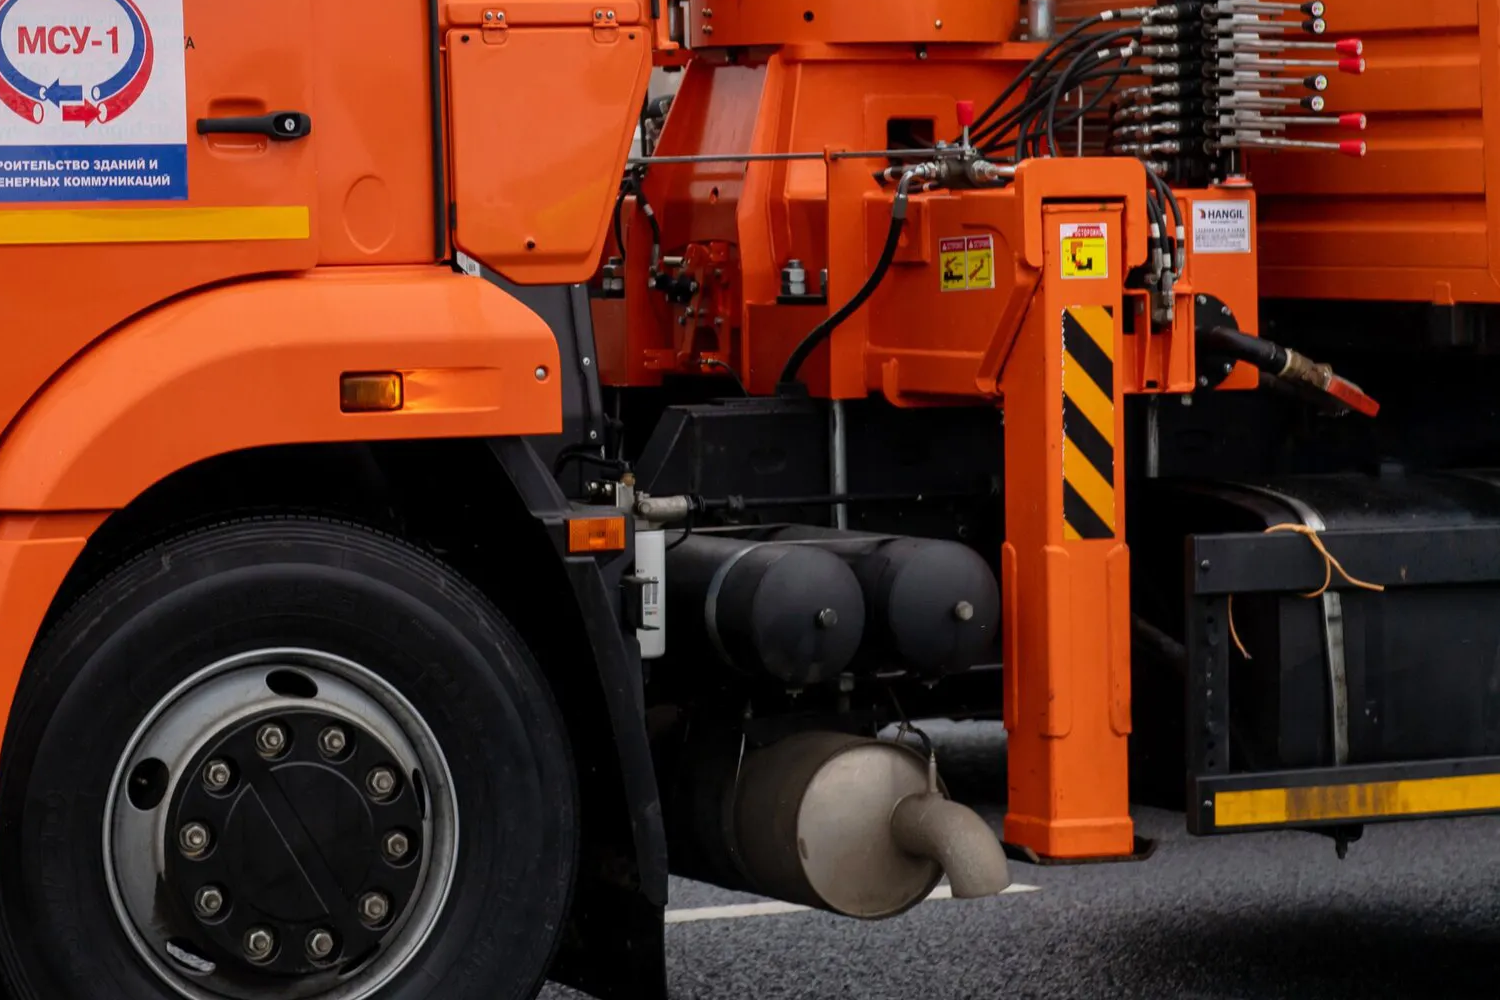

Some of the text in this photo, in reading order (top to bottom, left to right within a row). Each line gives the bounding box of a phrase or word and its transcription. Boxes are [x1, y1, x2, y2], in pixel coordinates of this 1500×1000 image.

[18, 26, 119, 55] МСУ-1
[93, 157, 145, 172] ЗДАНИЙ
[149, 159, 158, 170] И
[63, 173, 171, 188] КОММУНИКАЦИЙ
[1208, 209, 1245, 220] HANGIL
